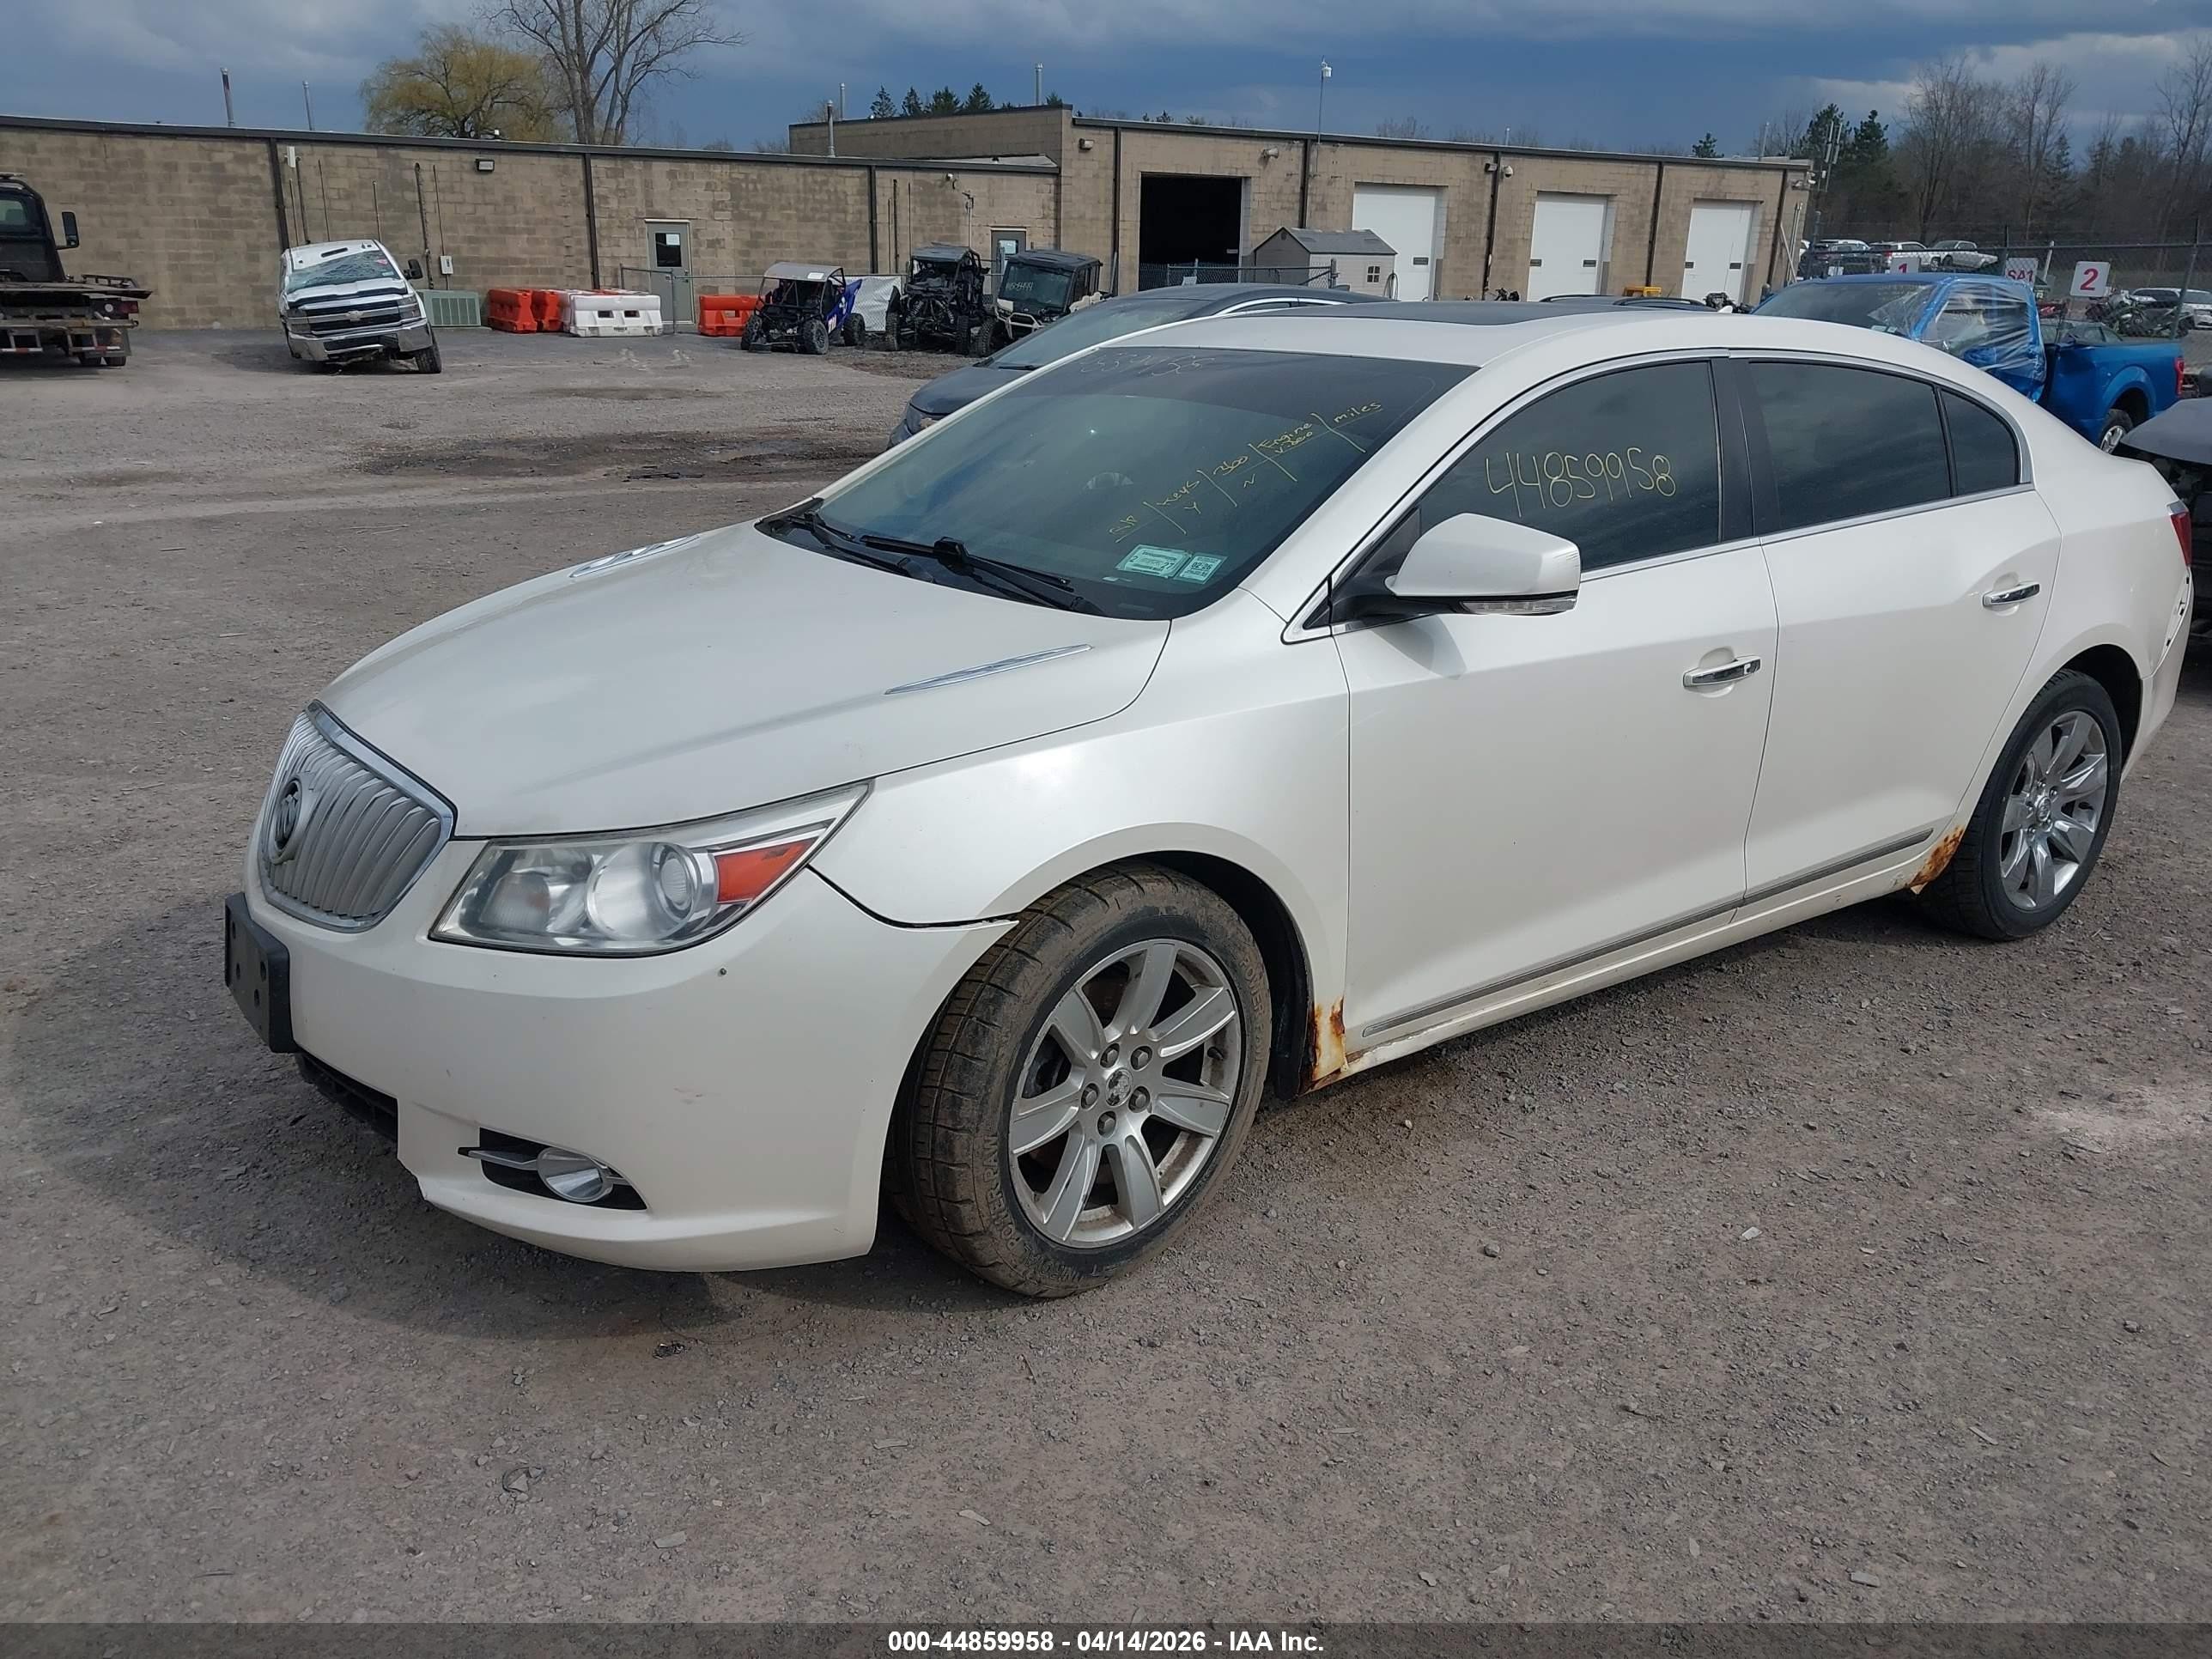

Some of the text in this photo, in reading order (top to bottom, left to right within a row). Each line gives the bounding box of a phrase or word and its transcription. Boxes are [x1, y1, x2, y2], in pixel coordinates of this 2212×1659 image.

[1898, 263, 1908, 274] 1
[2079, 267, 2099, 291] 2
[1334, 401, 1382, 422] miles
[1486, 447, 1676, 518] 44859958
